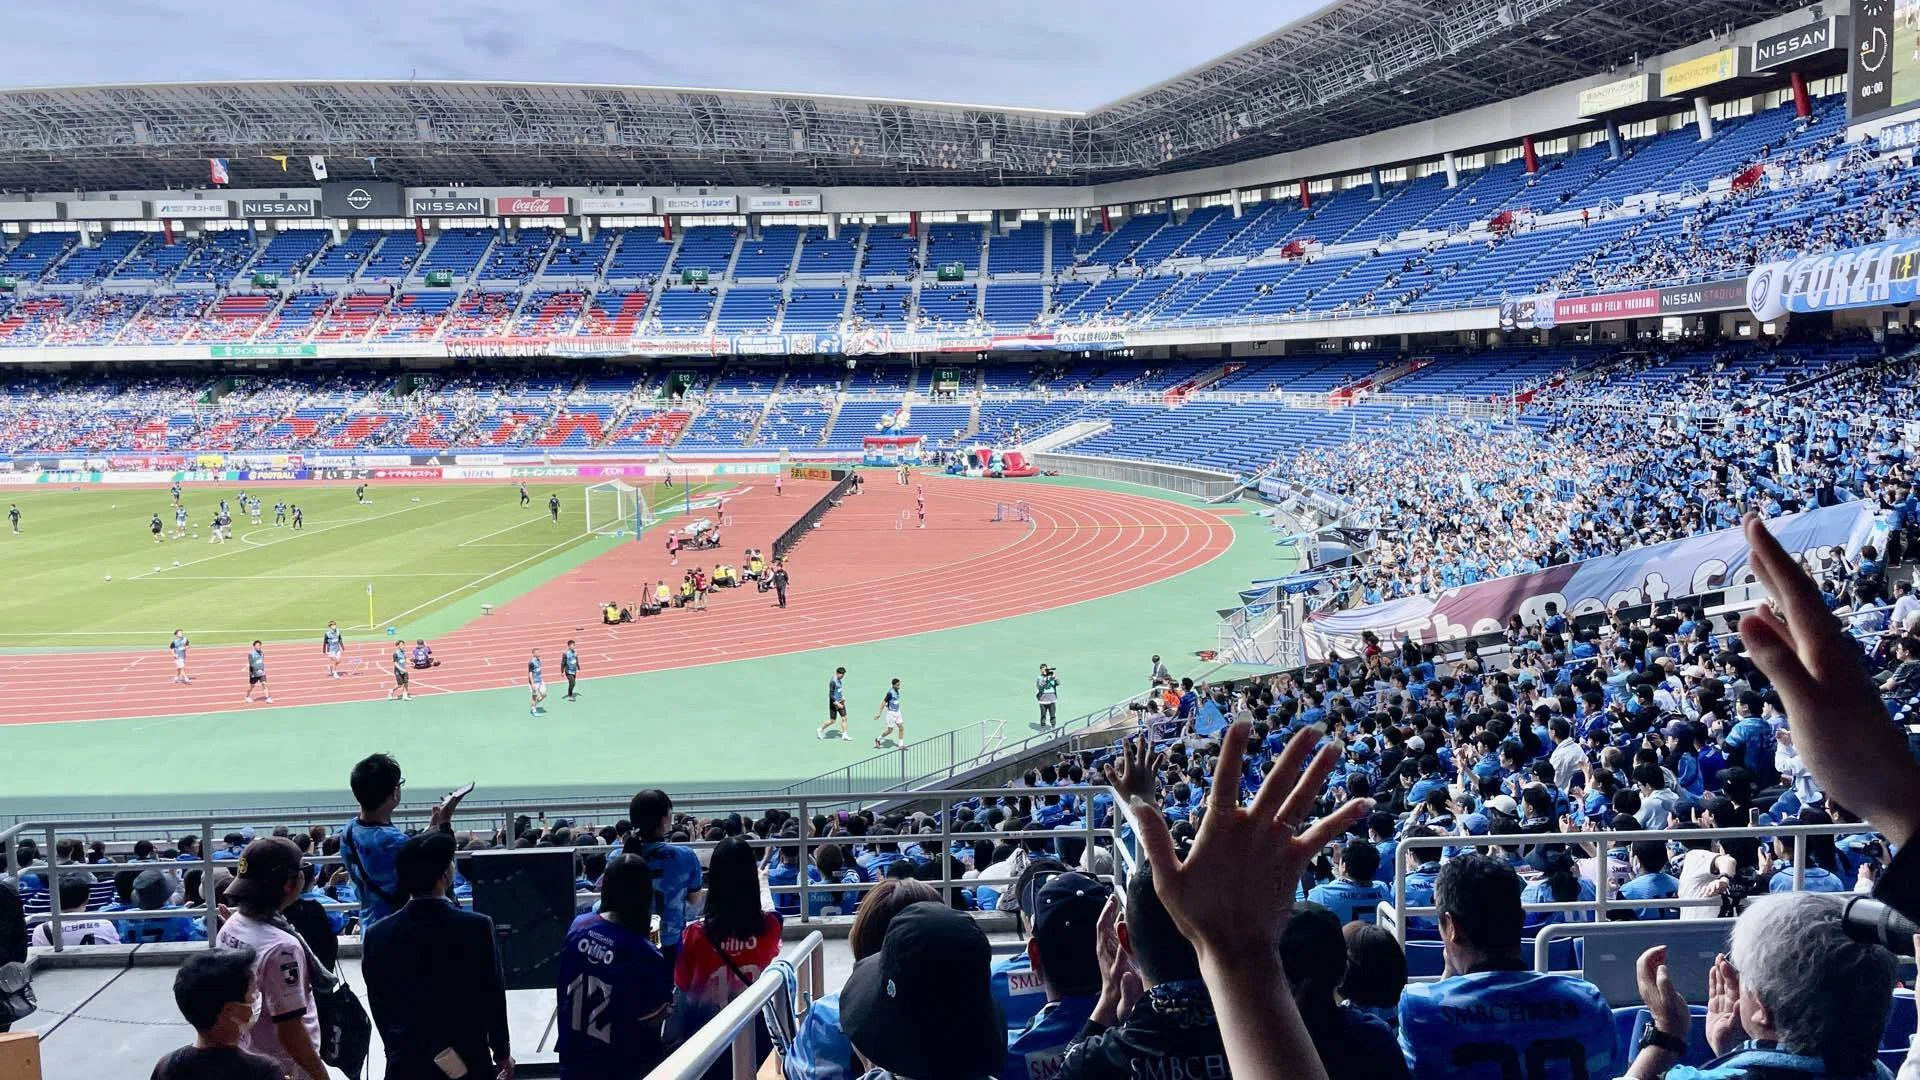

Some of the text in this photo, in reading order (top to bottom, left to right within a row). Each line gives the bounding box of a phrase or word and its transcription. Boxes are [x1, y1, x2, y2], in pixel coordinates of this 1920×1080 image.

[1758, 28, 1826, 61] NISSAN
[1861, 82, 1884, 98] 00:00
[245, 202, 309, 213] NISSAN
[416, 201, 478, 211] NISSAN
[945, 266, 956, 274] E21
[1784, 244, 1900, 309] FORZA
[1662, 287, 1744, 306] NISSAN STADIUM
[1559, 304, 1570, 316] OUR
[1571, 302, 1589, 315] HOME,
[1591, 301, 1603, 313] OUR
[1624, 296, 1655, 310] YOKOHAMA
[234, 379, 246, 387] E14
[413, 377, 425, 385] E13
[327, 470, 369, 480] いちご
[387, 470, 439, 478] ヤマザキビスケット
[567, 973, 613, 1045] 12
